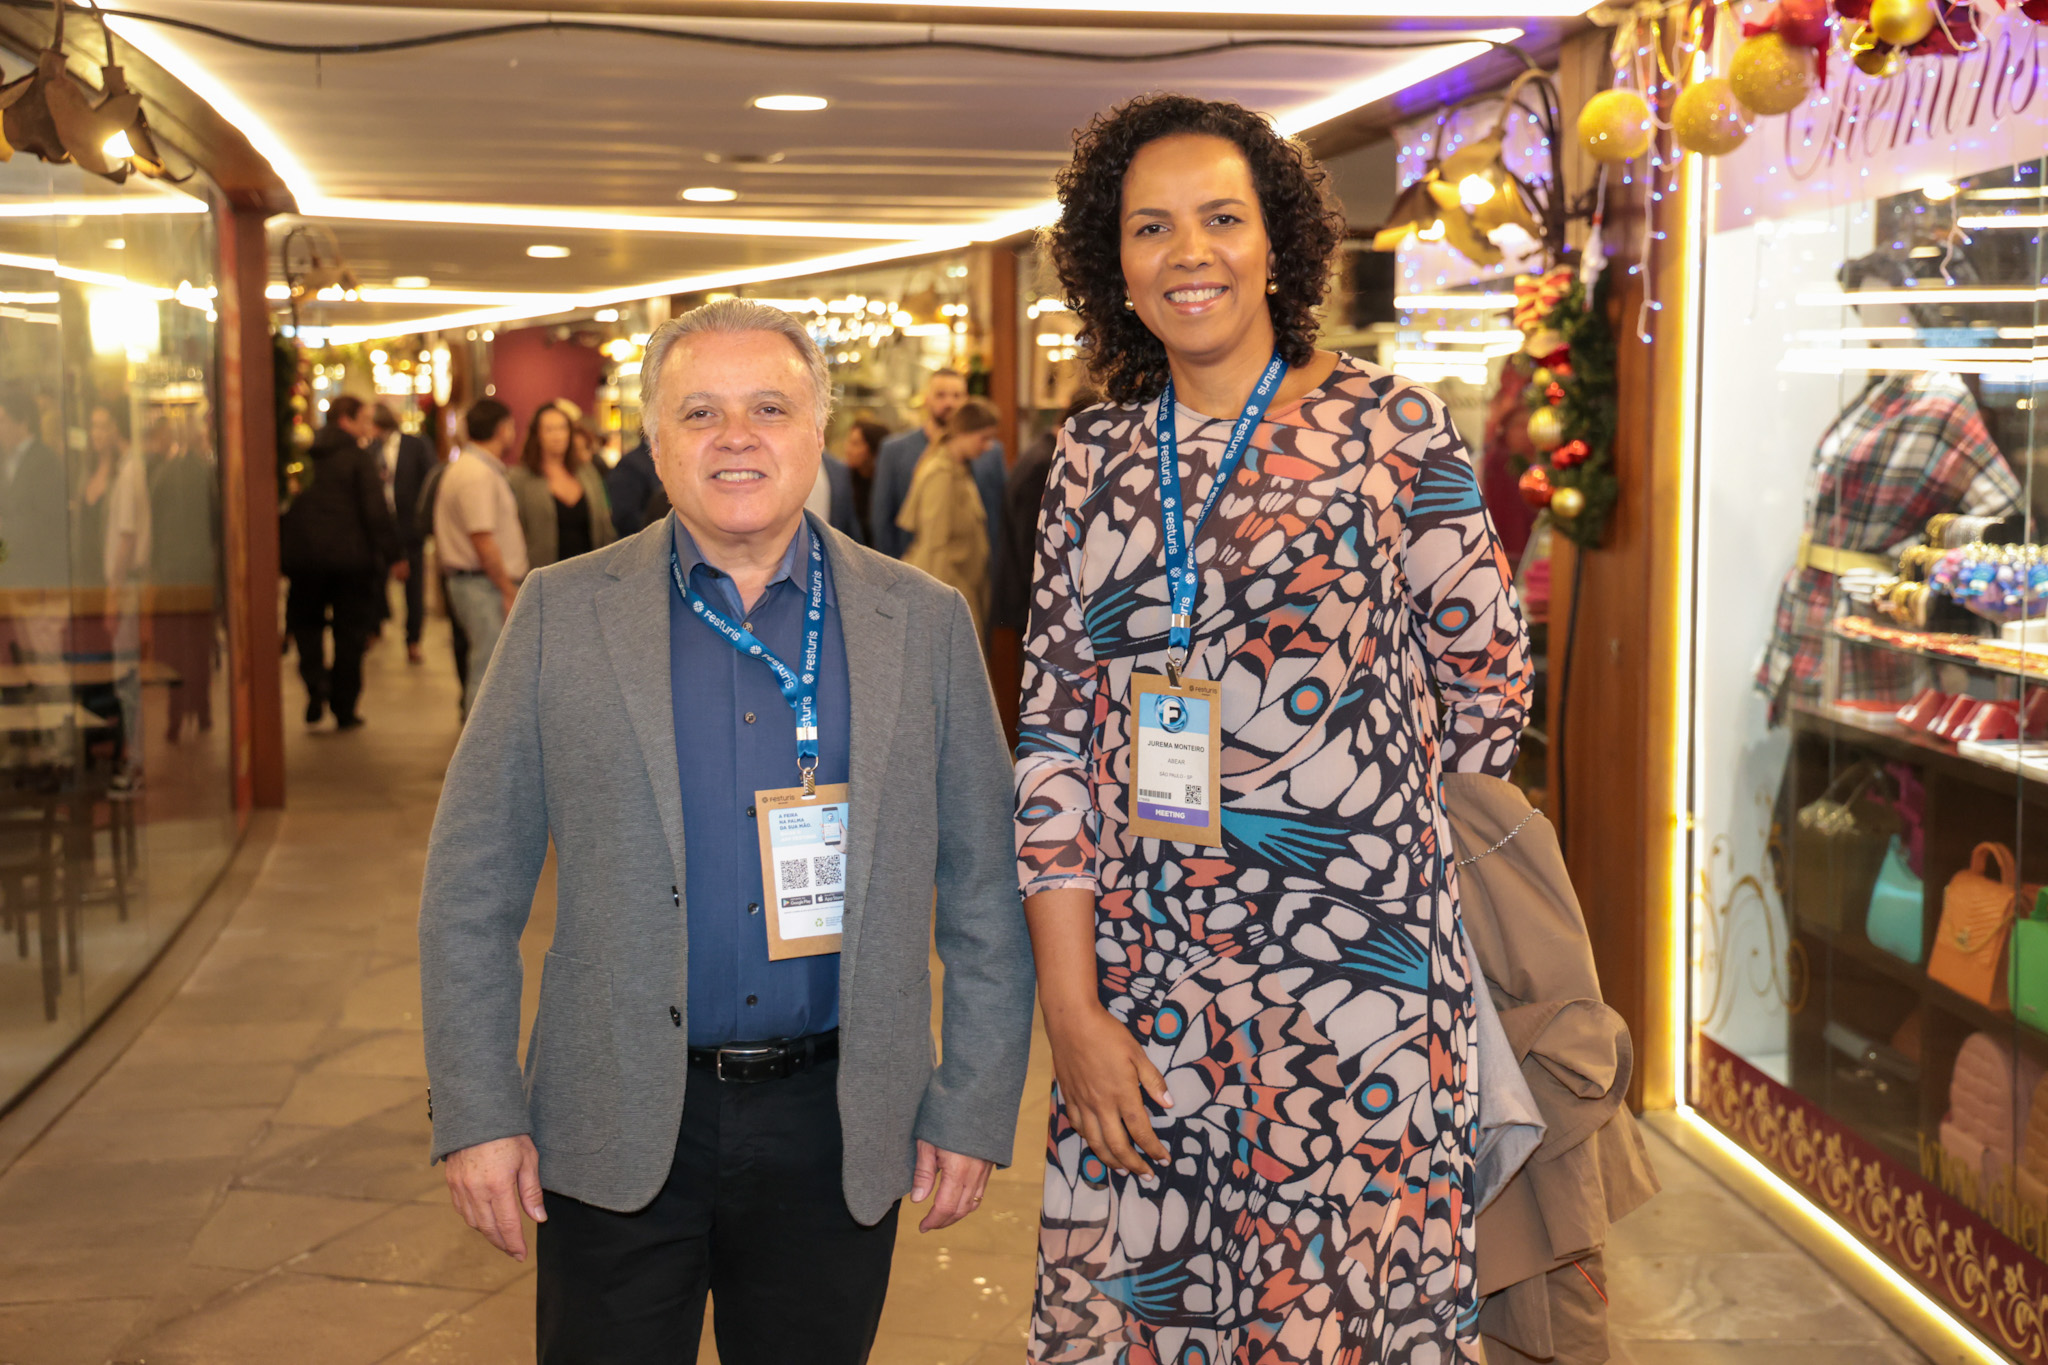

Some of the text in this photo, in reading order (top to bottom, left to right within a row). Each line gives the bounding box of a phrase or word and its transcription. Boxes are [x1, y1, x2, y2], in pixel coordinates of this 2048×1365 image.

[1225, 417, 1251, 459] Festuris
[1160, 445, 1171, 486] Festuris
[1165, 511, 1179, 555] Festuris
[812, 569, 822, 608] Festuris
[703, 610, 742, 642] Festuris
[805, 630, 818, 671] Festuris
[761, 653, 794, 690] Festuris
[1195, 686, 1217, 694] Festuris
[1147, 740, 1205, 753] JUREMA MONTEIRO
[769, 794, 795, 802] Festuris
[1155, 809, 1186, 819] MEETING
